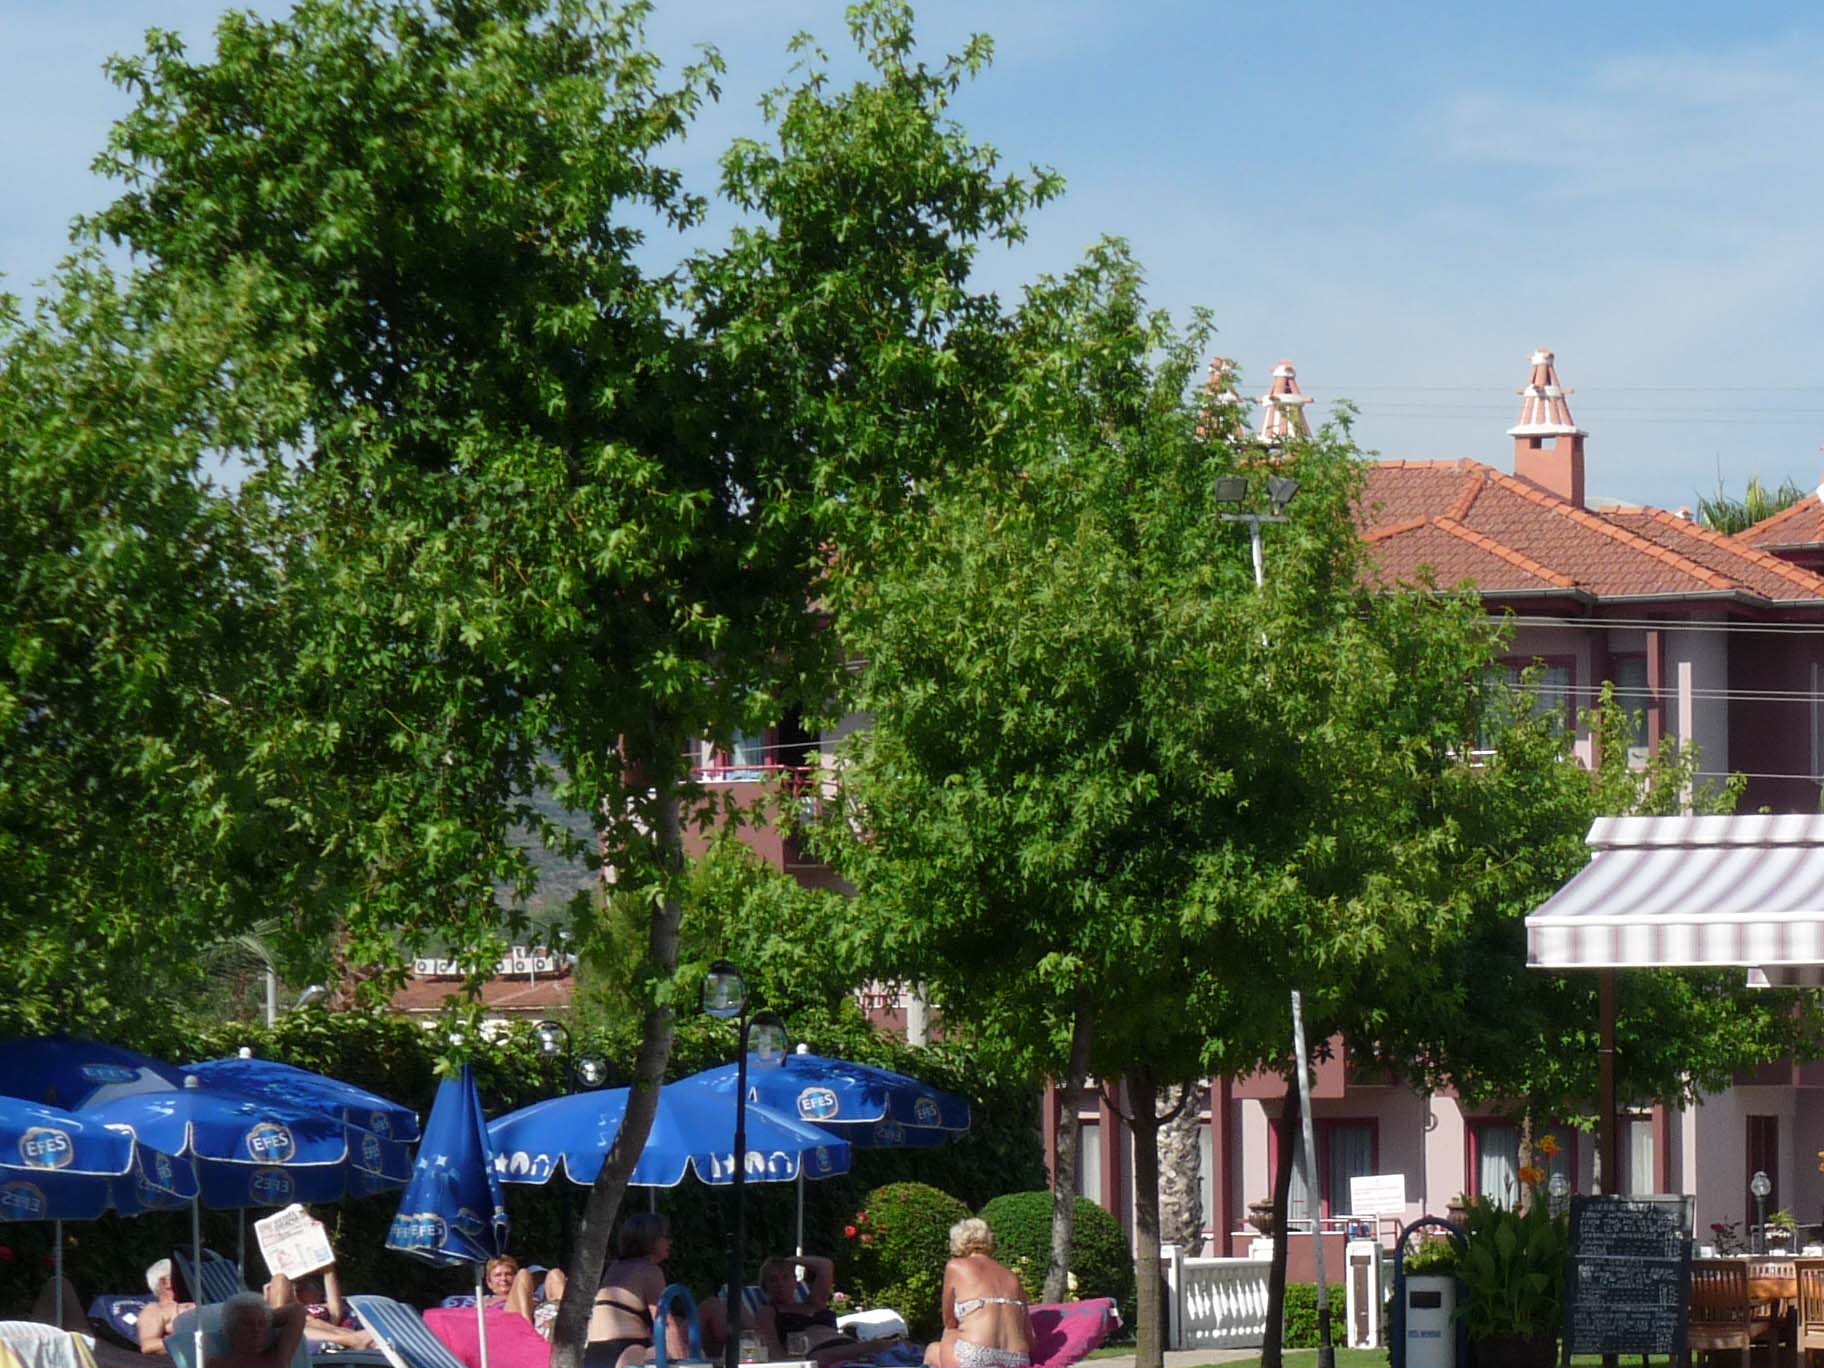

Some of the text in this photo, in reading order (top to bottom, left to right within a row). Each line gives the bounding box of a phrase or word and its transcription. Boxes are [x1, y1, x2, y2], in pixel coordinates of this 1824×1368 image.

[802, 1094, 834, 1111] EFES
[26, 1135, 67, 1156] EFES
[252, 1134, 289, 1151] EFES
